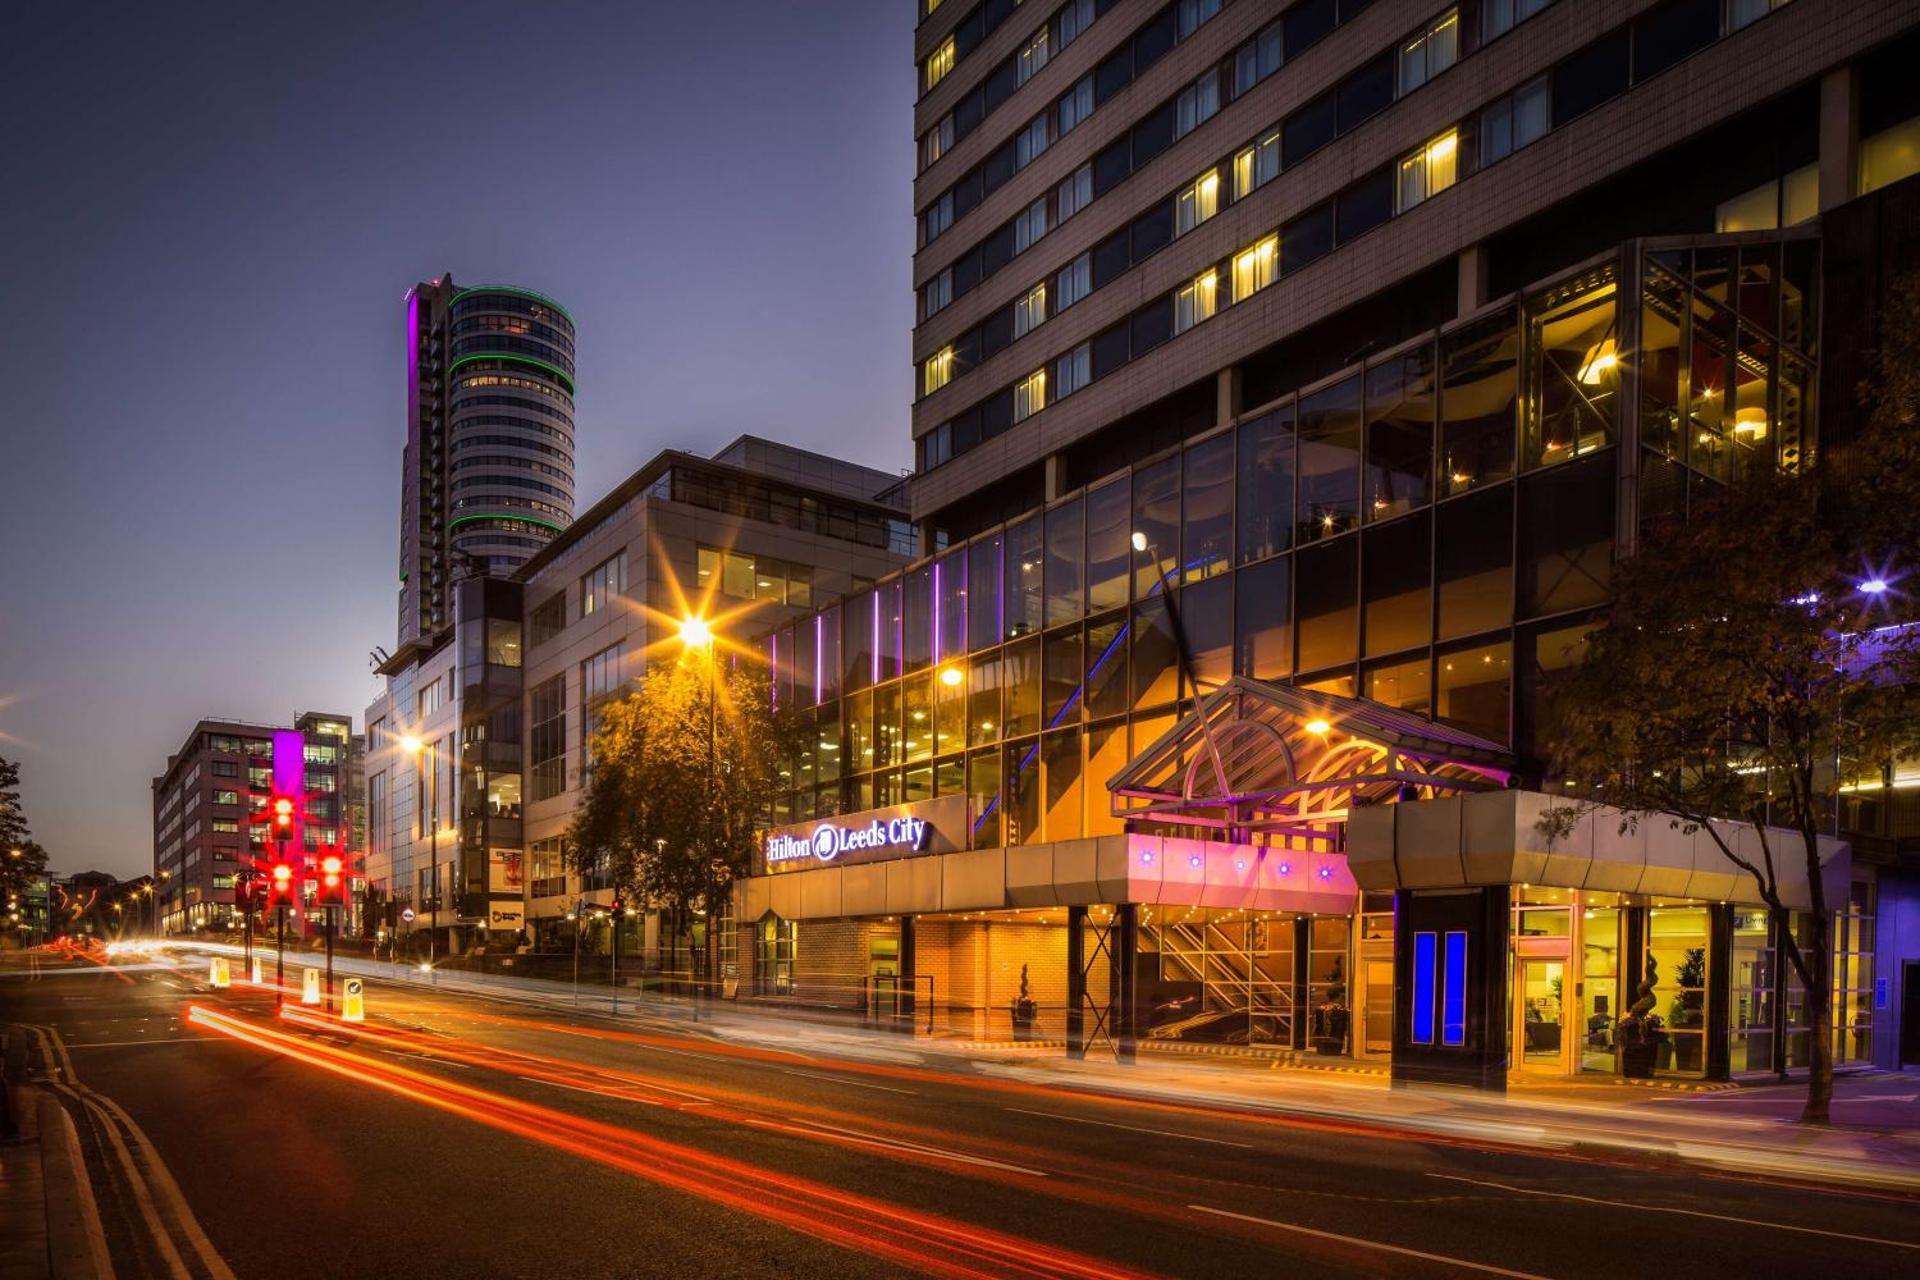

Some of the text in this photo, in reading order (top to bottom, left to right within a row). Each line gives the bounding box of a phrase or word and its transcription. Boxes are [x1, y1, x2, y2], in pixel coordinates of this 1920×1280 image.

[767, 815, 925, 861] Hilton Leeds City
